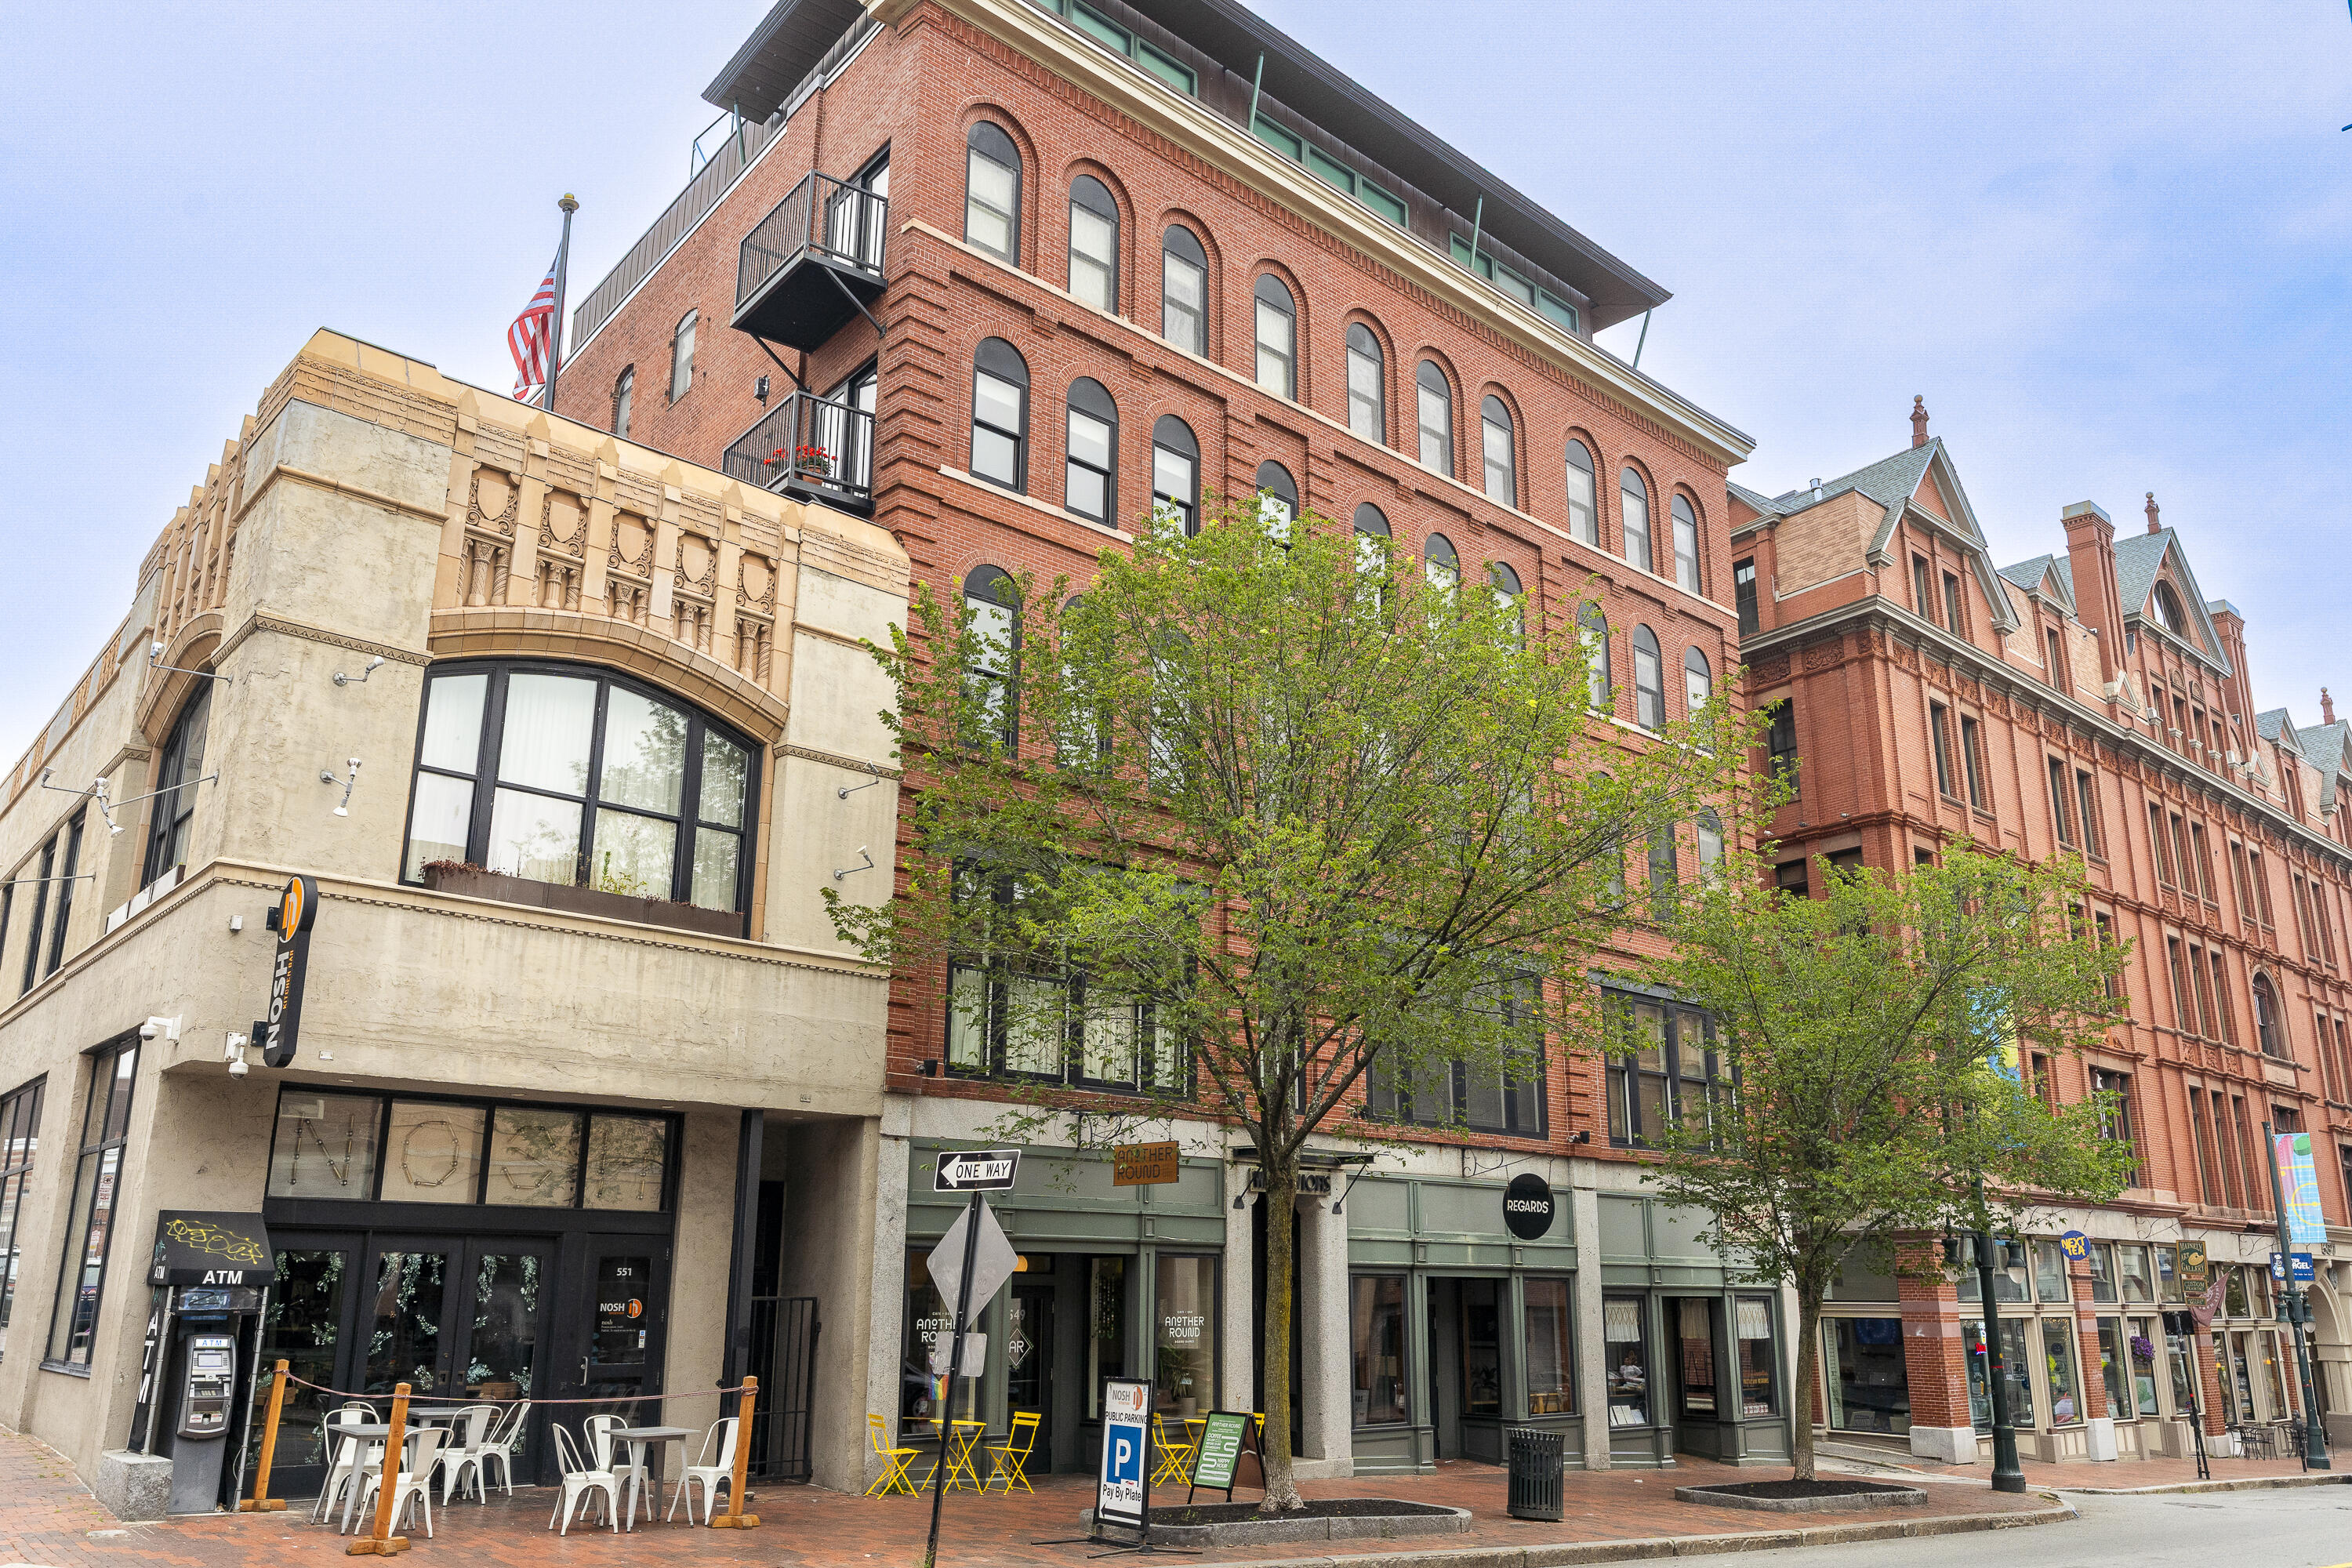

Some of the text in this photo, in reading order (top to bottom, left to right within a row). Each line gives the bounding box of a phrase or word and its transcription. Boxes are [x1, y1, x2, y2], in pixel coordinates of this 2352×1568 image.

[282, 971, 292, 1010] KITCHEN
[266, 951, 290, 1050] NOSH
[1117, 1146, 1174, 1163] ANOTHER
[956, 1162, 1010, 1178] ONE WAY
[1117, 1164, 1161, 1180] ROUND
[1507, 1200, 1549, 1214] REGARDS
[2061, 1236, 2085, 1250] NEXT
[2067, 1245, 2085, 1256] TEA
[2180, 1252, 2190, 1261] ART
[154, 1265, 165, 1279] ATM
[616, 1268, 633, 1276] 551
[2181, 1261, 2205, 1272] GALLERY
[202, 1270, 243, 1285] ATM
[600, 1303, 625, 1312] NOSH
[916, 1319, 956, 1330] ANOTH
[1165, 1316, 1204, 1327] ANOTHER
[1169, 1327, 1200, 1338] ROUND
[138, 1307, 159, 1403] ATM
[1112, 1390, 1131, 1401] NOSH
[1105, 1410, 1123, 1421] PUBLIC
[1114, 1438, 1131, 1477] P
[1102, 1483, 1142, 1502] Pay By Plate
